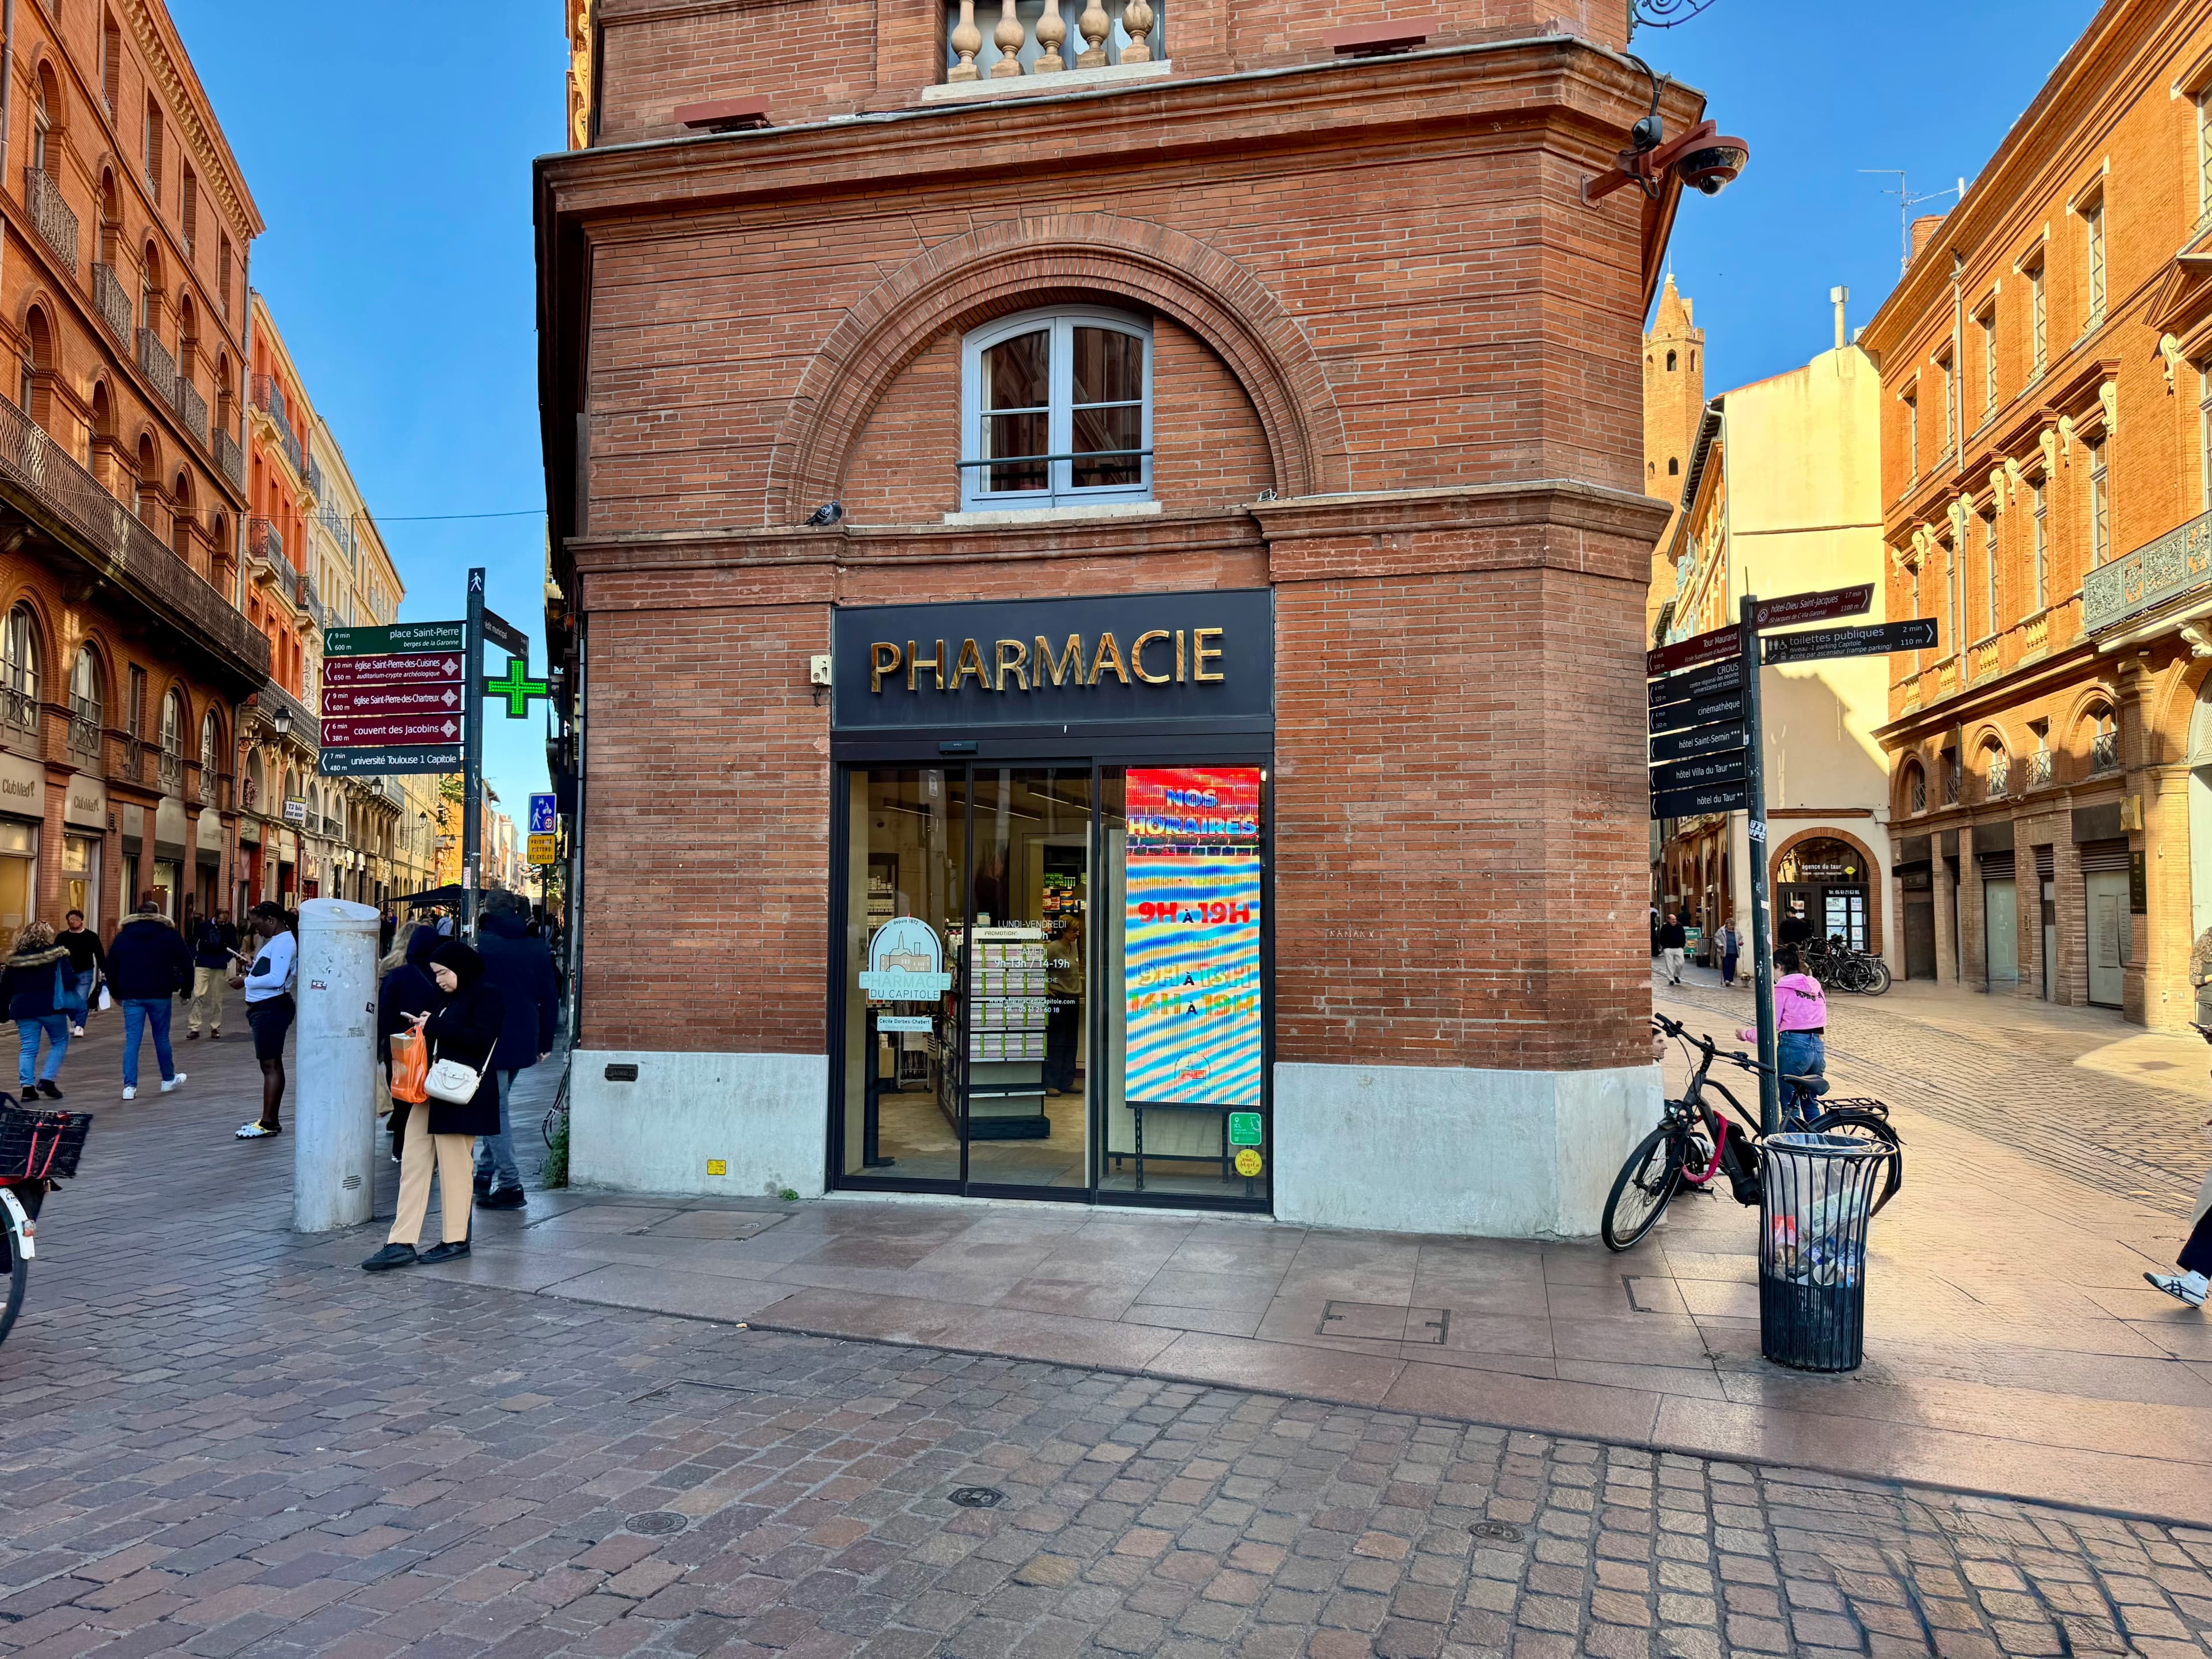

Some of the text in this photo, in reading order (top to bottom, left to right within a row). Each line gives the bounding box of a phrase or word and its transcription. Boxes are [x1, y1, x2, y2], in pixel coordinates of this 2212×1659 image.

[1770, 595, 1839, 613] hôtel-Dieu Saint-Jacques
[1768, 613, 1791, 624] (St-Jacques
[390, 628, 459, 640] place Saint-Pierre
[492, 626, 507, 639] municipal
[1790, 628, 1885, 645] toilettes publiques
[1703, 631, 1737, 648] Tour Maurand
[1816, 643, 1837, 652] parking
[1838, 640, 1861, 649] Capitole
[1847, 646, 1867, 655] (rampe
[1868, 643, 1892, 653] parking)
[355, 659, 440, 671] église Saint-Pierre-des-Cuisines
[870, 627, 1224, 692] PHARMACIE
[1717, 662, 1738, 675] CROUS
[1694, 684, 1717, 694] universitaires
[1723, 678, 1739, 687] scolaires
[1701, 676, 1716, 686] régional
[354, 694, 439, 706] église Saint-Pierre-des-Chartreux
[1698, 700, 1740, 715] cinémathèque
[354, 724, 439, 735] couvent des Jacobins
[1679, 733, 1730, 749] hôtel Saint-Sernin
[351, 753, 457, 765] université Toulouse 1 Capitole
[1676, 764, 1728, 779] hôtel Villa du Taur
[3, 779, 30, 798] Club Med
[1166, 789, 1218, 807] NOS
[1697, 793, 1736, 805] hôtel du Taur
[1128, 815, 1257, 835] HORAIRES
[1138, 902, 1250, 923] 9H À 19H
[998, 920, 1066, 928] LUNDI-VENDREDI
[995, 959, 1027, 968] 9h-13h
[1039, 959, 1070, 968] 14-19h
[861, 975, 949, 988] PHARMACIE
[1183, 971, 1194, 986] À
[871, 990, 939, 999] DU CAPITOLE
[1186, 1001, 1197, 1015] À
